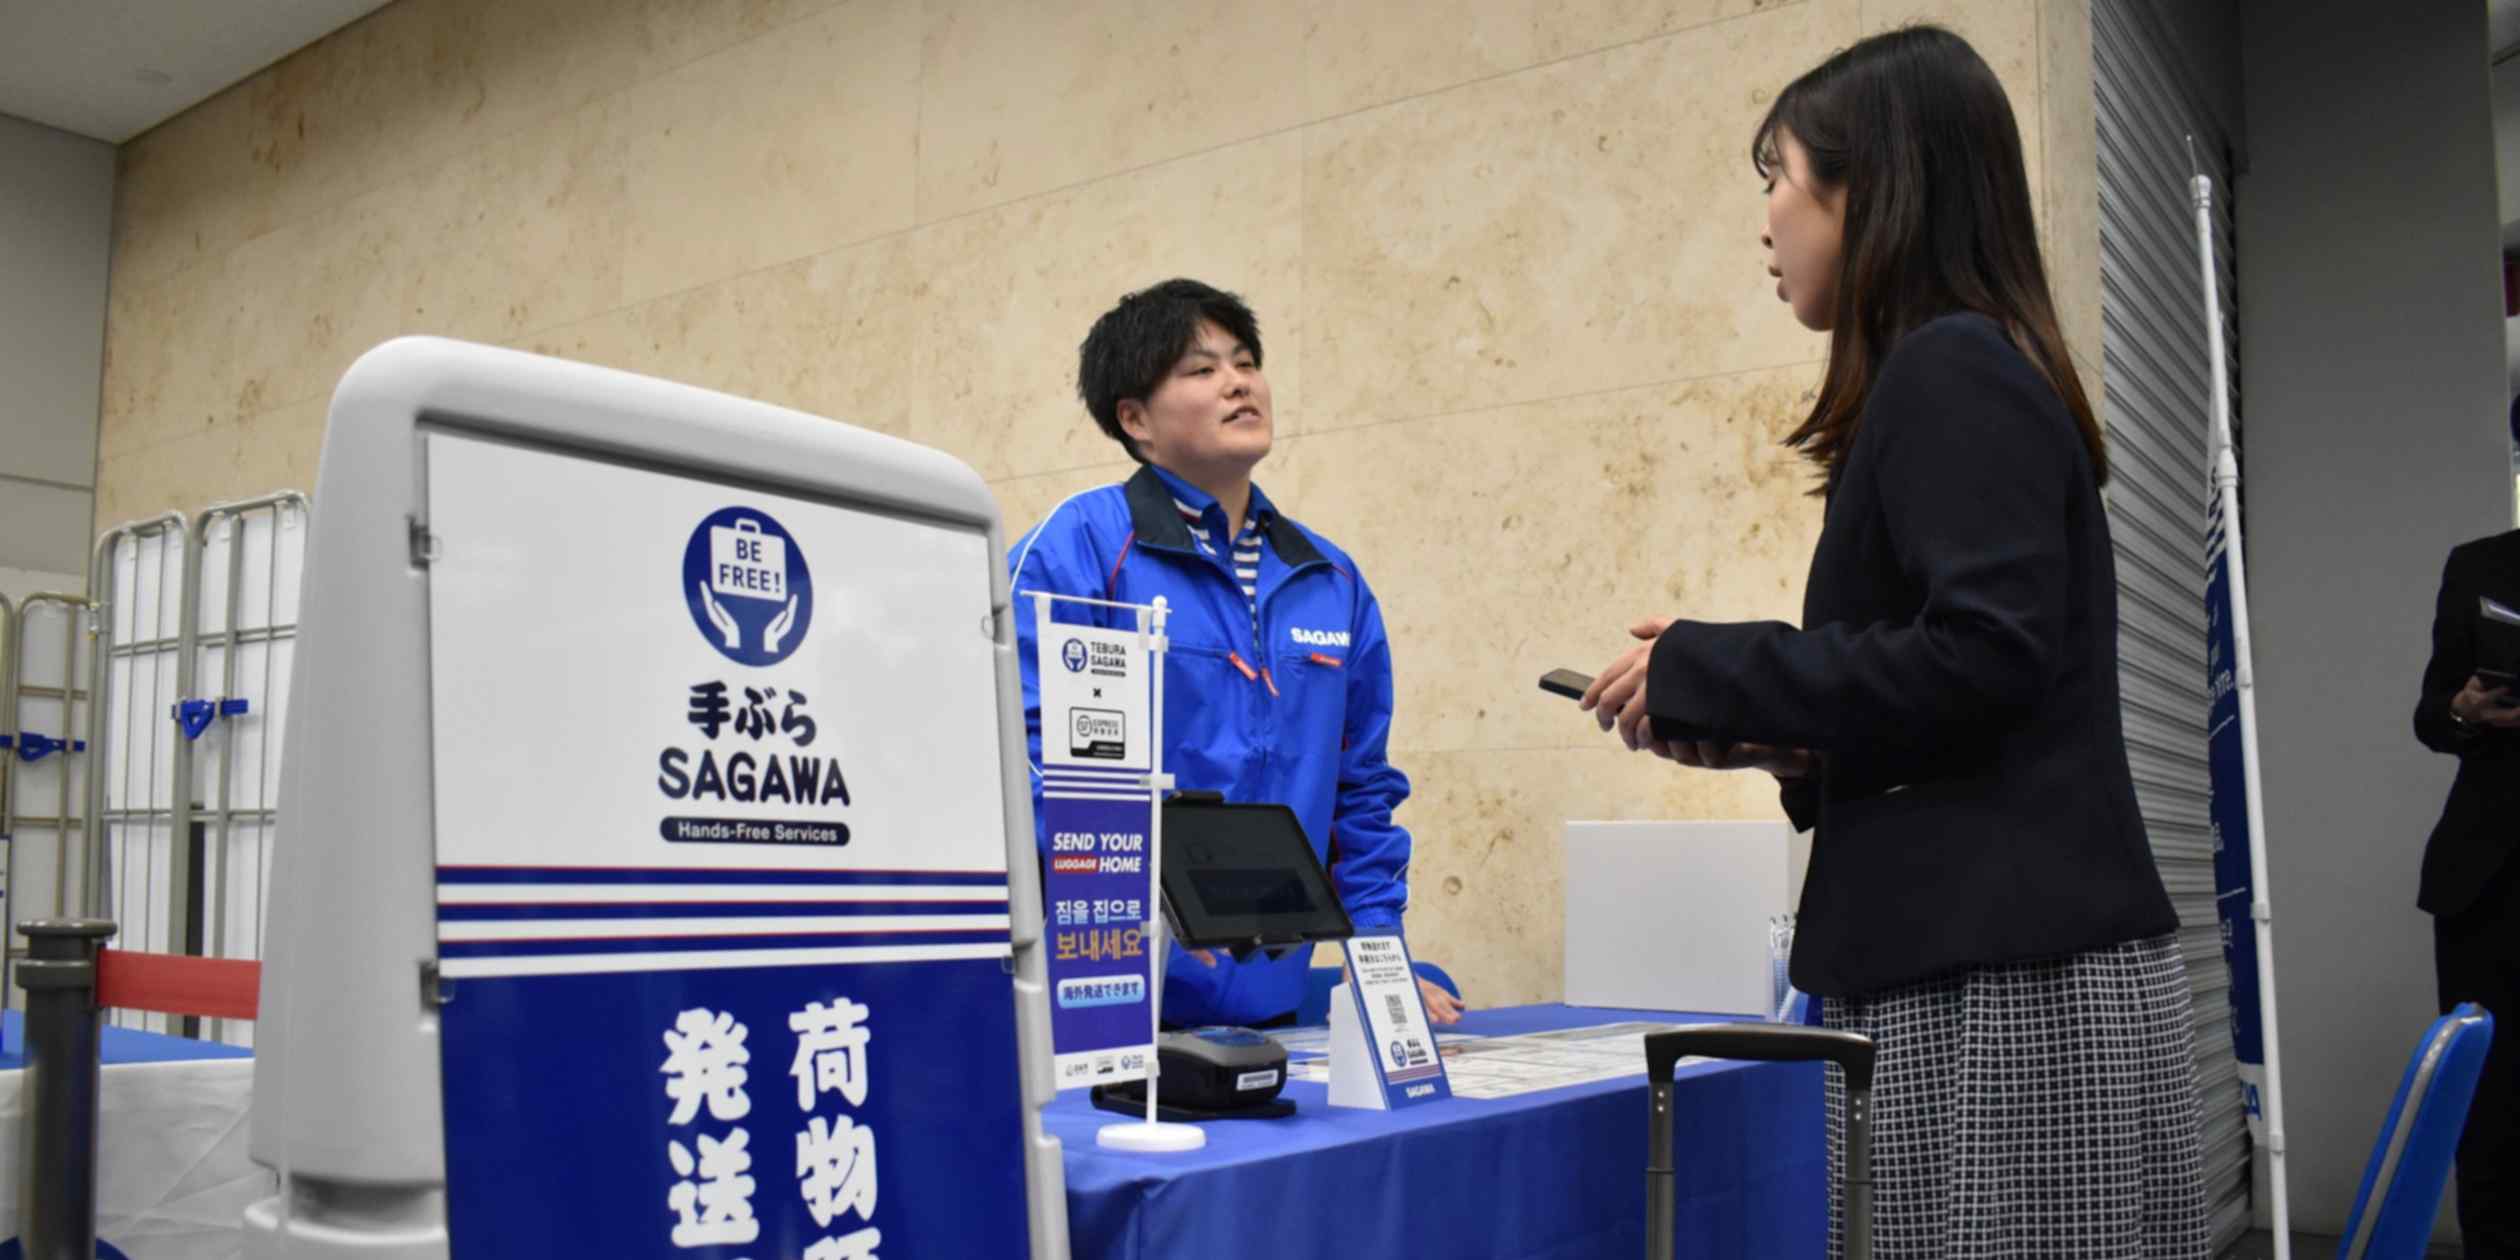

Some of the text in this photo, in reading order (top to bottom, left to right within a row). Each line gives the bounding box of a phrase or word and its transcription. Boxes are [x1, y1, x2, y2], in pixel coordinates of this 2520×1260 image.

[736, 538, 762, 563] BE
[719, 563, 781, 593] FREE!
[1090, 641, 1126, 656] TEBURA
[1090, 654, 1126, 668] SAGAWA
[688, 679, 817, 747] 手ぶら
[658, 746, 851, 807] SAGAWA
[677, 822, 838, 843] Hands-Free Services
[1053, 832, 1143, 852] SEND YOUR
[1054, 856, 1142, 874] LUGGAGE HOME
[1055, 899, 1142, 926] 짐을 집으로
[1055, 928, 1143, 961] 보내세요
[659, 1006, 760, 1260] 発送
